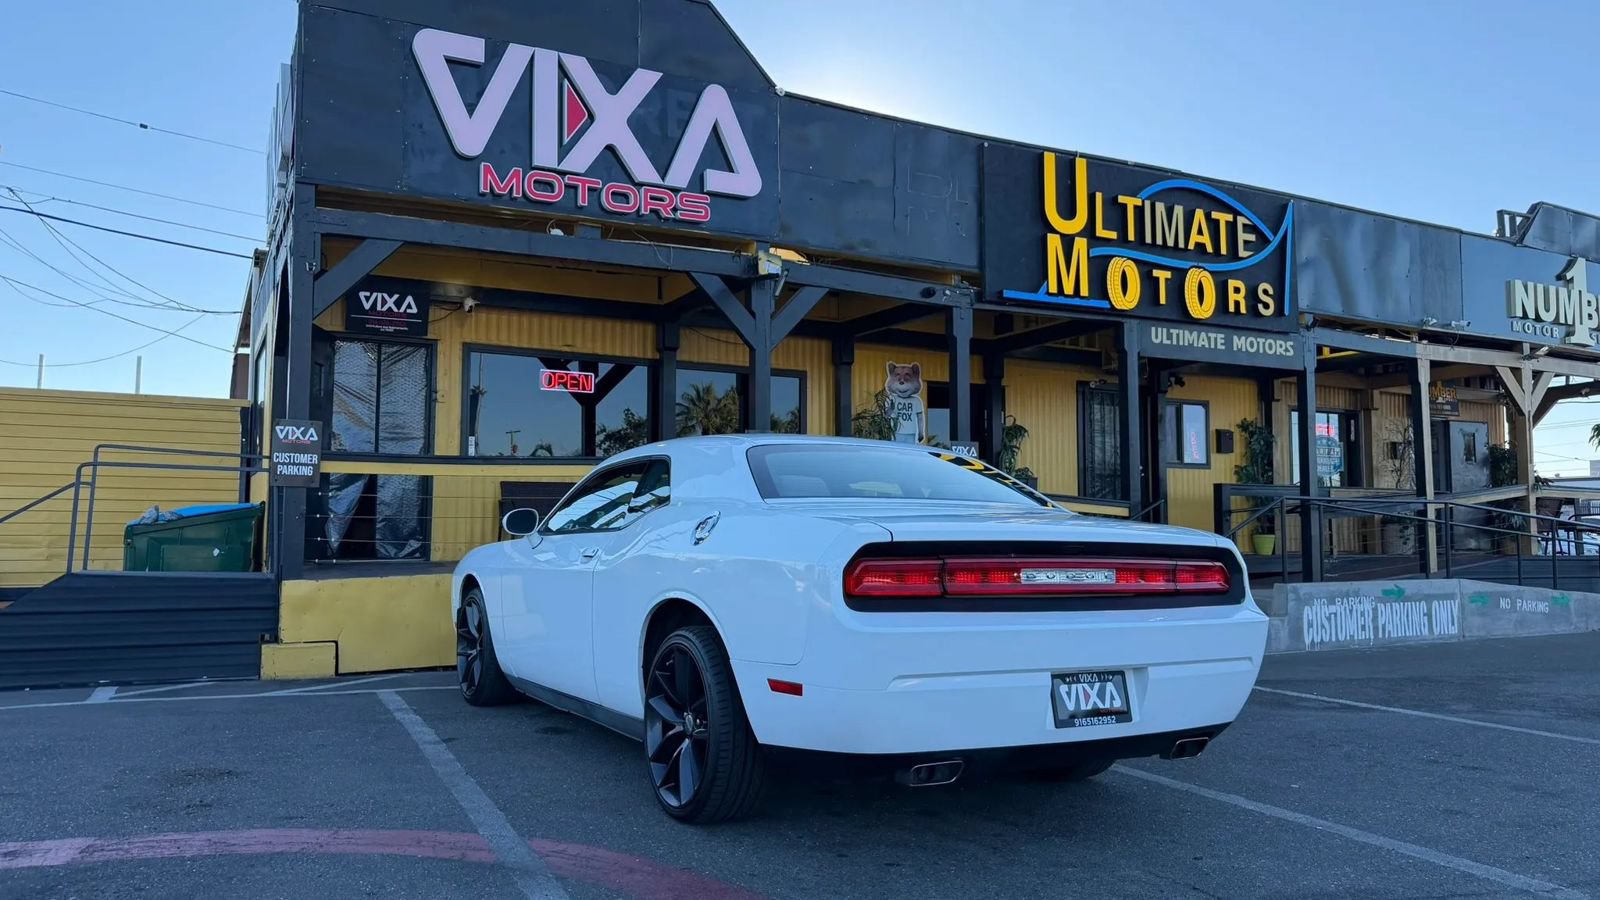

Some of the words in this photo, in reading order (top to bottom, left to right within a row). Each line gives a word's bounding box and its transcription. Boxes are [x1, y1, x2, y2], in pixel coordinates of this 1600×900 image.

[411, 28, 762, 197] VIXA
[480, 162, 711, 222] MOTORS
[1043, 151, 1257, 258] ULTIMATE
[1046, 233, 1275, 319] MOTORS
[359, 291, 418, 313] VIXA
[1508, 279, 1600, 330] NUMB
[1511, 321, 1560, 338] MOTOR
[1151, 327, 1225, 349] ULTIMATE
[1233, 335, 1294, 356] MOTORS
[542, 371, 592, 391] OPEN
[897, 402, 912, 412] CAR
[897, 411, 912, 422] FOX
[275, 426, 318, 441] VIXA
[273, 453, 318, 464] CUSTOMER
[277, 465, 313, 476] PARKING
[1500, 597, 1511, 609] NO
[1516, 599, 1549, 614] PARKING
[1303, 605, 1375, 643] CUSTOMER
[1378, 601, 1429, 639] PARKING
[1432, 599, 1460, 635] ONLY
[1078, 673, 1099, 683] VIXA
[1059, 682, 1122, 711] VIXA
[1074, 715, 1117, 727] 9165162952
